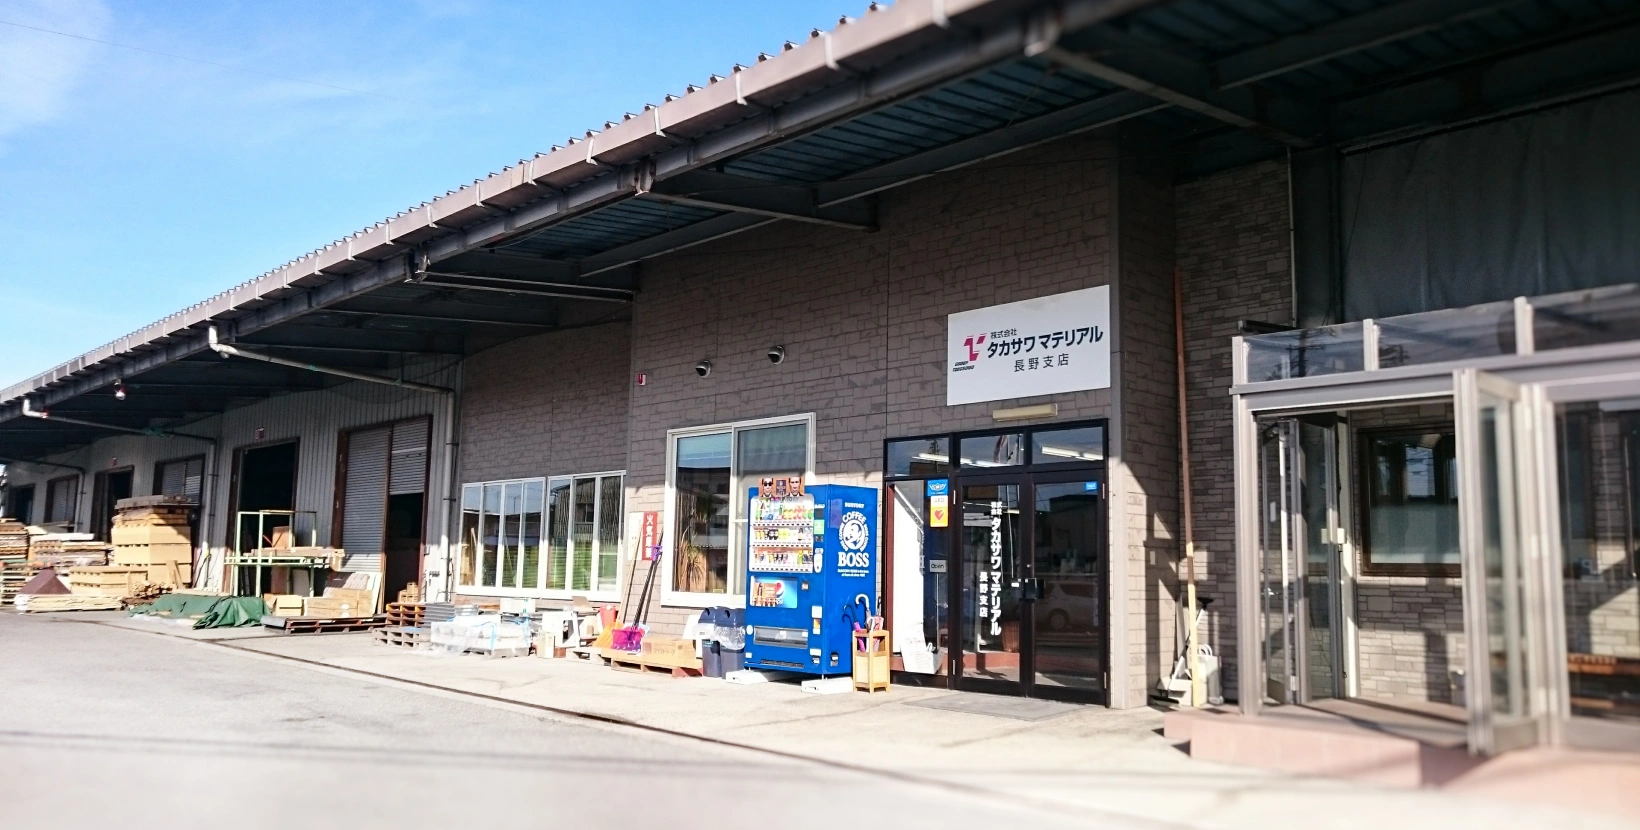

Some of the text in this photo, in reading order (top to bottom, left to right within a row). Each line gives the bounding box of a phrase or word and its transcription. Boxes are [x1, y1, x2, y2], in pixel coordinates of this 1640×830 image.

[990, 328, 1018, 339] 株式会社
[1014, 353, 1070, 373] 長野支店
[842, 511, 867, 524] COFFEE
[837, 551, 870, 568] BOSS
[979, 571, 989, 618] 長野支店
